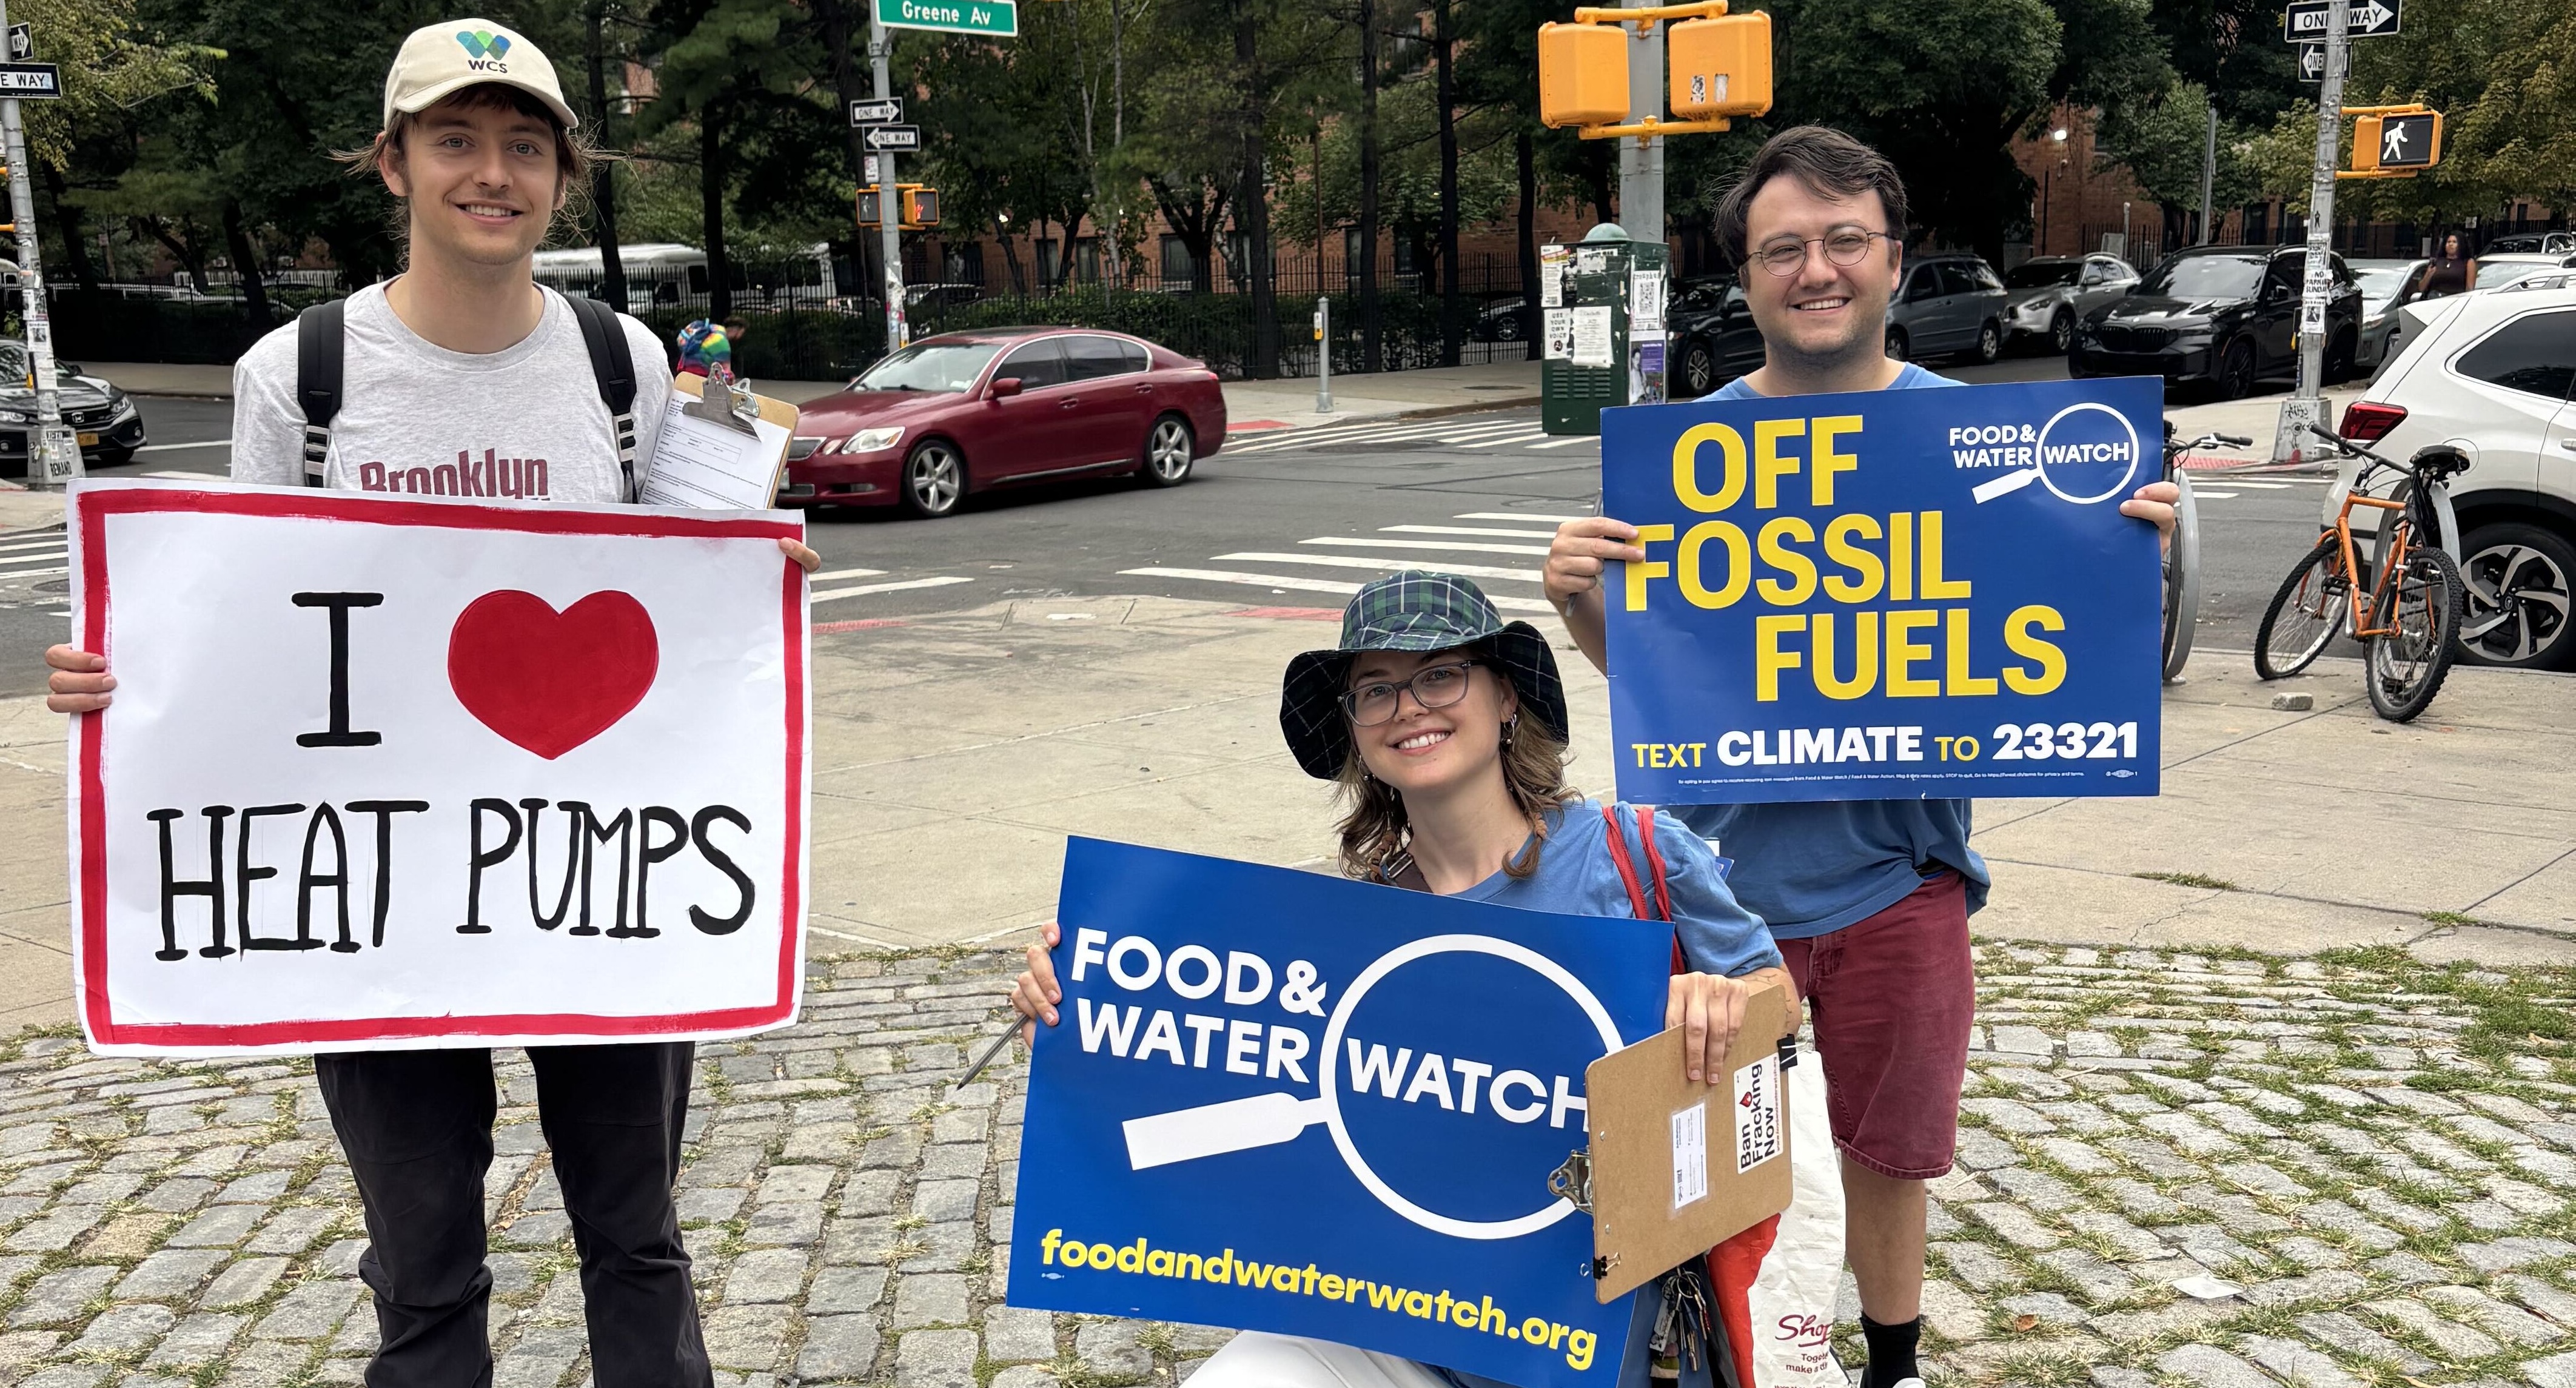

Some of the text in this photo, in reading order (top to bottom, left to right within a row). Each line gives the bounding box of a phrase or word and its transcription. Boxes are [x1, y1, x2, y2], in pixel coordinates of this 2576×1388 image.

[902, 1, 991, 25] Greene Av
[2350, 8, 2382, 25] WAY
[16, 73, 44, 87] WAY
[468, 59, 508, 73] WCS
[2308, 55, 2323, 69] ONE
[859, 107, 894, 118] ONE WAY
[873, 133, 911, 143] ONE WAY
[360, 448, 548, 499] Brooklyn
[1673, 415, 1863, 513] OFF
[1953, 441, 2130, 468] WATER WATCH
[1625, 511, 1971, 611] FOSSIL
[291, 592, 384, 748] I
[1756, 605, 2067, 702] FUELS
[1632, 722, 2138, 769] TEXT CLIMATE TO 23321
[146, 798, 756, 961] HEAT PUMPS
[1077, 997, 1589, 1133] WATER WATCH
[1751, 1064, 1763, 1163] Fracking
[1764, 1107, 1775, 1158] Now
[1741, 1123, 1751, 1169] Ban
[1041, 1228, 1597, 1370] foodandwaterwatch.org
[1785, 1364, 1813, 1374] make
